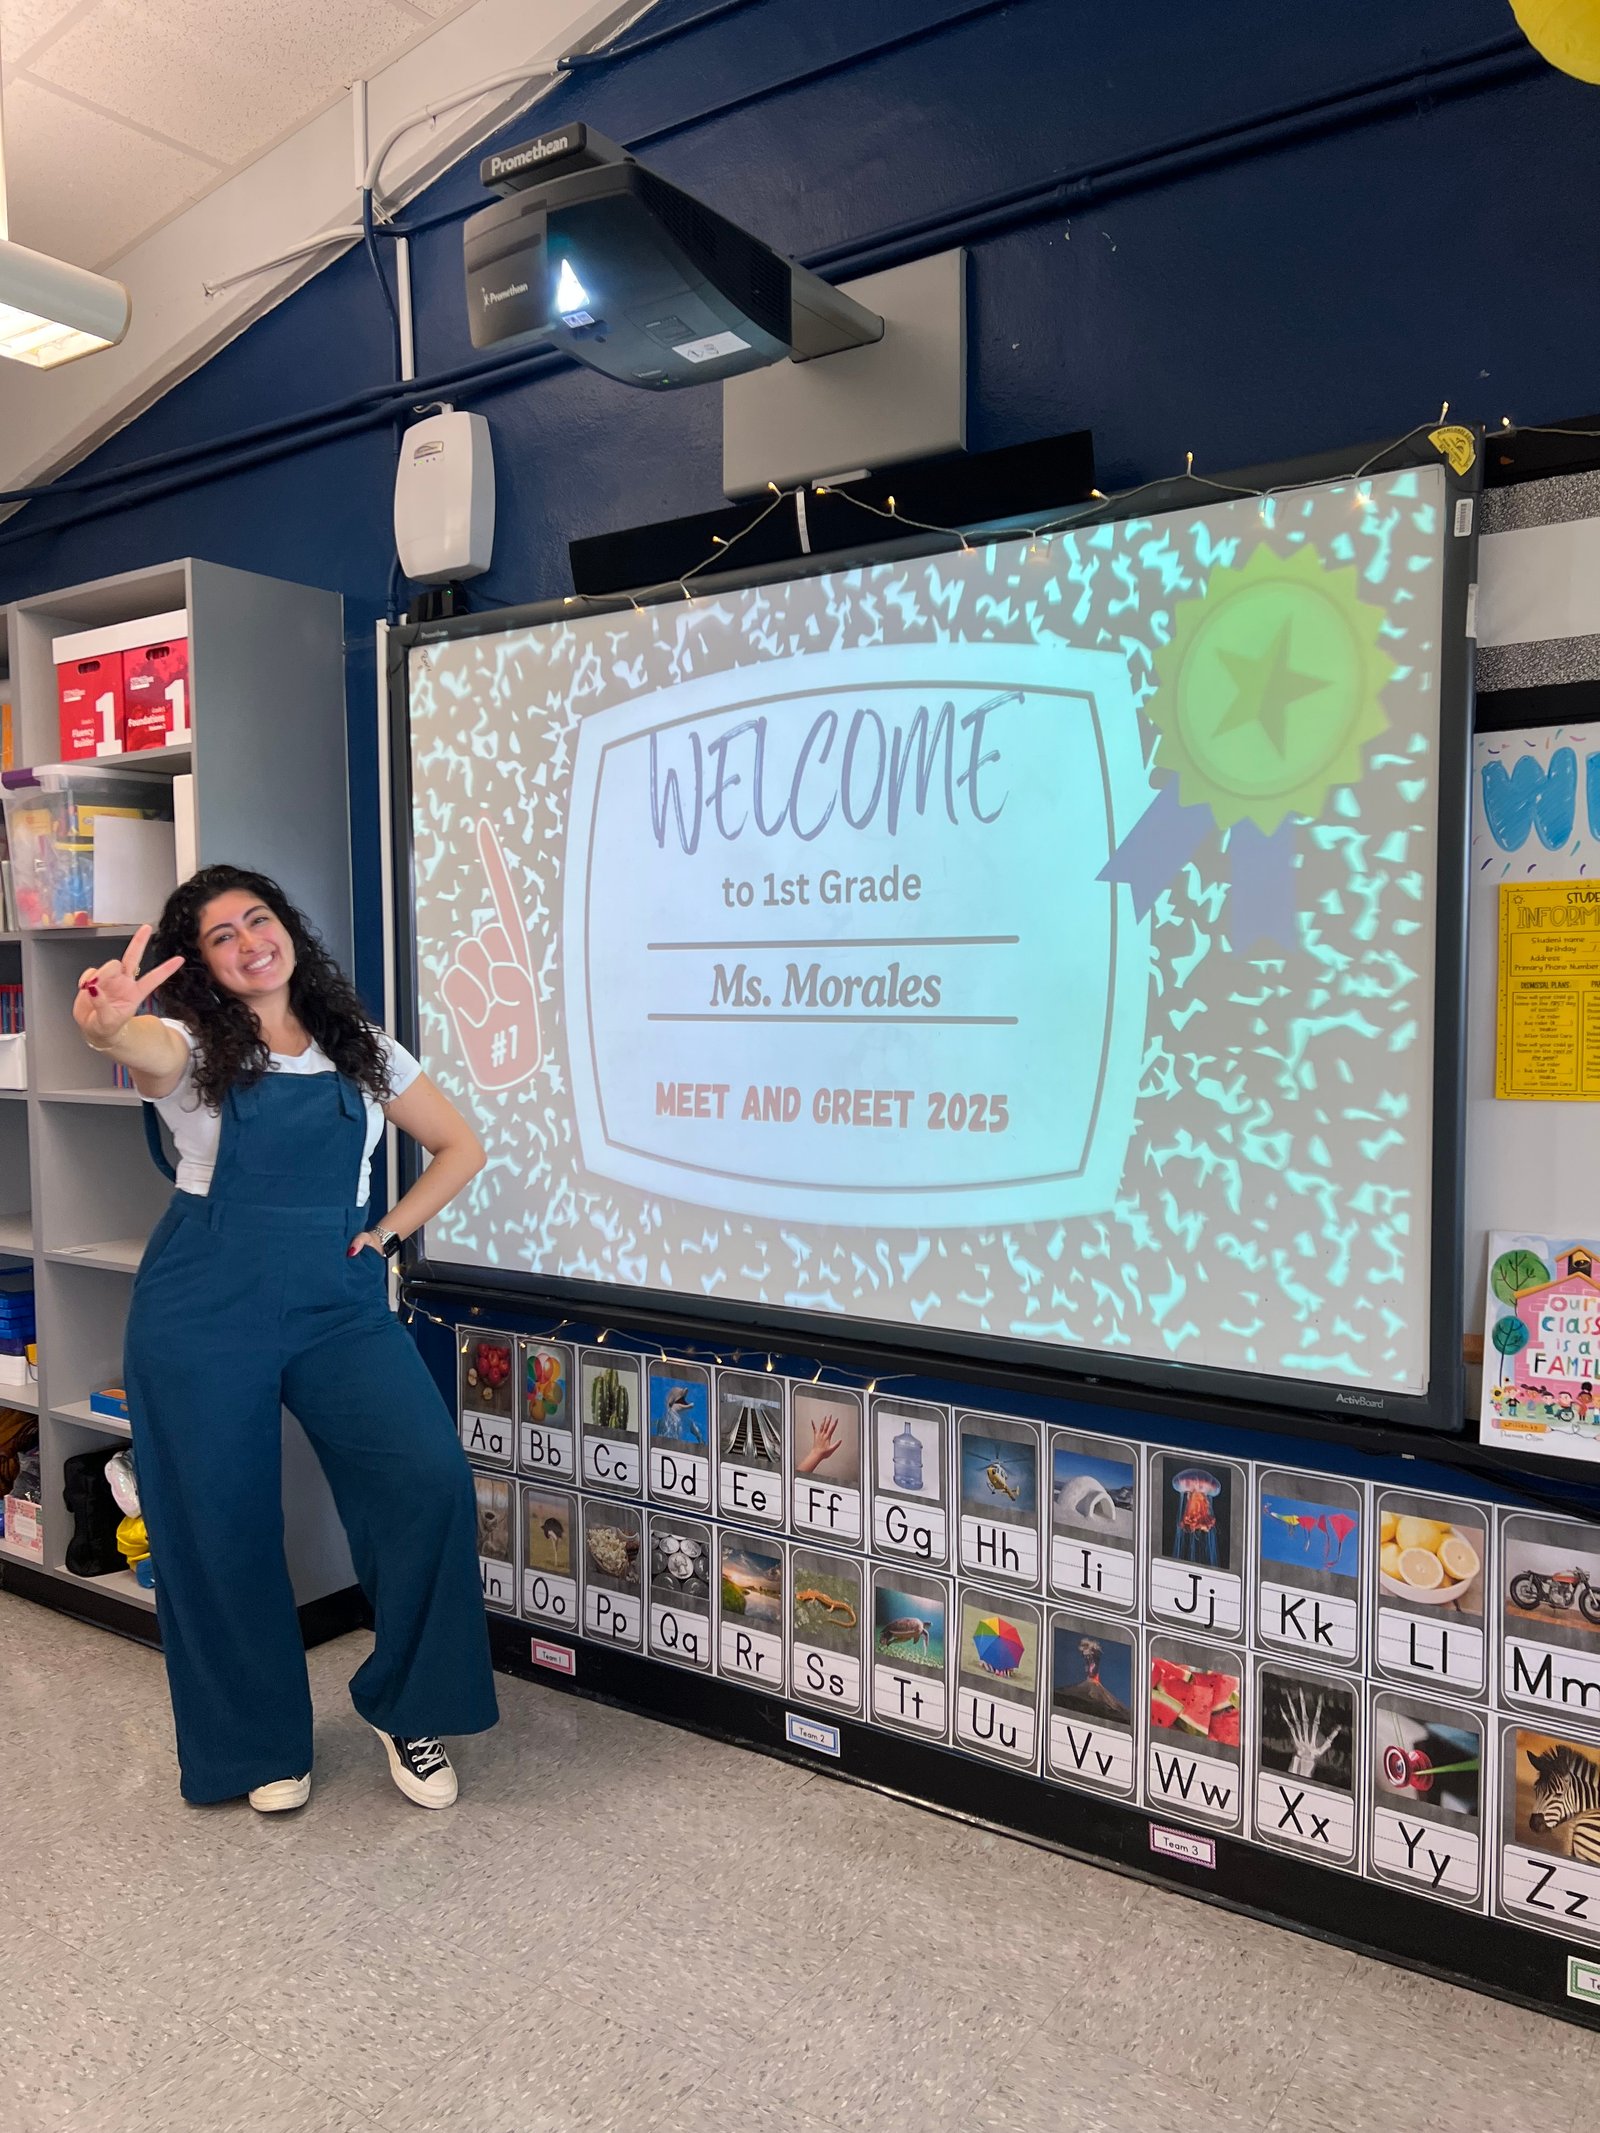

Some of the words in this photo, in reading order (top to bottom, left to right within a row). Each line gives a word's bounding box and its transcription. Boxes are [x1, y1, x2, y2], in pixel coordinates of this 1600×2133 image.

[491, 136, 568, 176] Promethean
[95, 691, 122, 757] 1
[165, 678, 192, 746] 1
[649, 690, 1025, 855] WELCOME
[722, 876, 754, 907] to
[762, 872, 810, 906] 1st
[819, 865, 922, 904] Grade
[1517, 905, 1600, 929] INFORM
[709, 963, 771, 1008] Ms.
[782, 962, 942, 1008] Morales
[490, 1024, 518, 1068] #1
[655, 1082, 730, 1119] MEET
[741, 1085, 802, 1123] AND
[812, 1088, 915, 1129] GREET
[927, 1092, 1010, 1133] 2025
[1556, 1338, 1571, 1352] is
[1578, 1341, 1591, 1355] a
[1336, 1393, 1384, 1409] ActivBoard
[470, 1418, 503, 1454] Aa
[530, 1430, 561, 1467] Bb
[594, 1444, 628, 1481] Cc
[661, 1456, 696, 1495] Dd
[733, 1471, 767, 1511] Ee
[809, 1488, 842, 1527] Ff
[886, 1505, 932, 1559] Gg
[977, 1525, 1019, 1571] Hh
[1080, 1549, 1103, 1592] Ii
[532, 1577, 566, 1615] Oo
[597, 1593, 627, 1638] Pp
[1174, 1573, 1215, 1629] Jj
[660, 1612, 698, 1663] Qq
[1281, 1593, 1333, 1646] Kk
[542, 1650, 557, 1662] Team
[736, 1632, 765, 1672] Rr
[806, 1653, 845, 1696] Ss
[1513, 1646, 1600, 1707] Mm
[893, 1676, 924, 1719] Tt
[799, 1727, 818, 1741] Team
[820, 1734, 826, 1743] 2
[972, 1697, 1017, 1748] Uu
[1067, 1726, 1113, 1776] Vv
[1155, 1752, 1231, 1809] Ww
[1278, 1785, 1330, 1843] Xx
[1163, 1836, 1189, 1853] Team
[1191, 1845, 1199, 1856] 3
[1398, 1821, 1451, 1888] Yy
[1526, 1860, 1589, 1920] Zz
